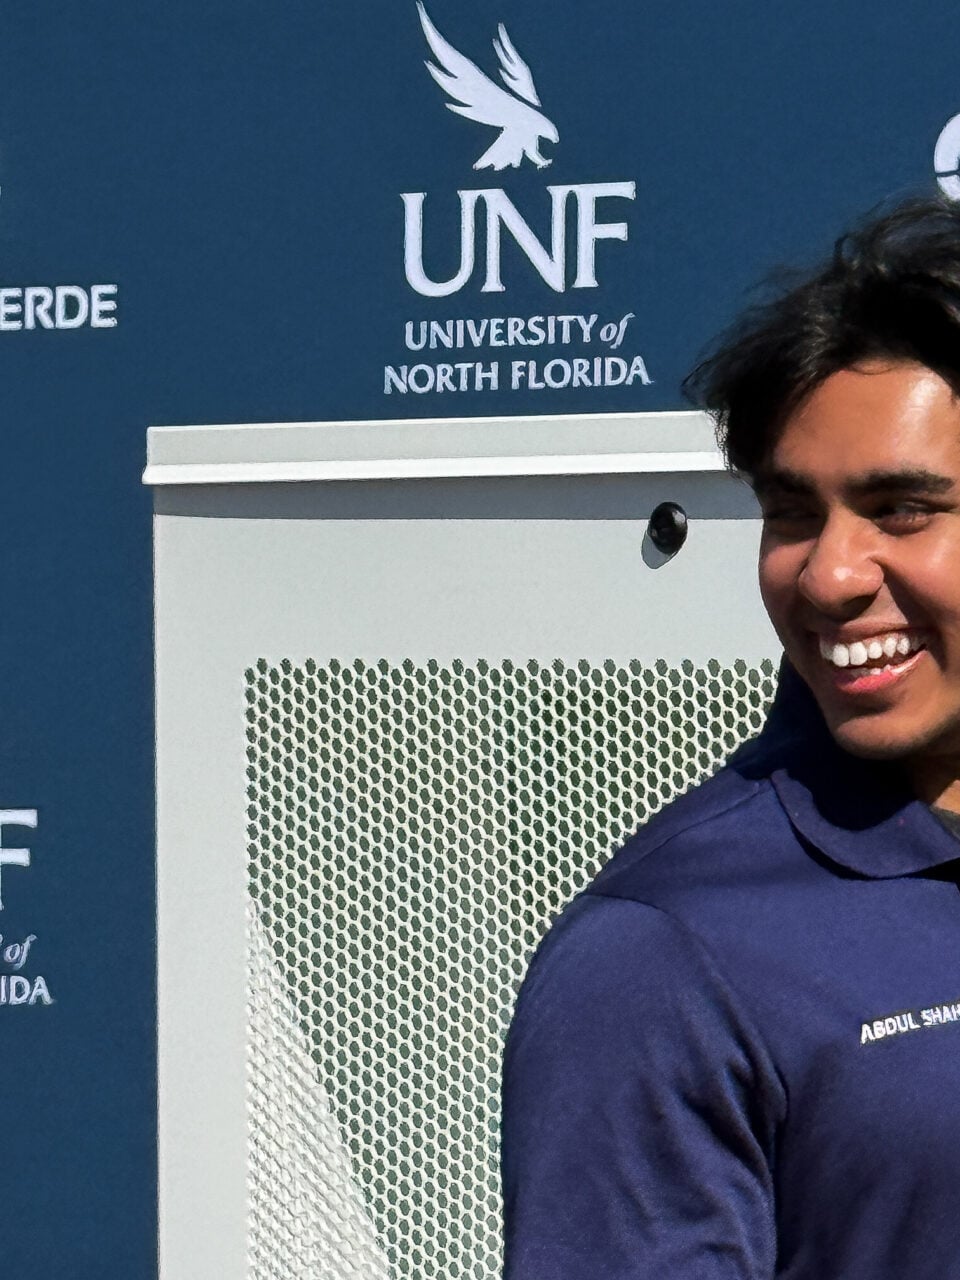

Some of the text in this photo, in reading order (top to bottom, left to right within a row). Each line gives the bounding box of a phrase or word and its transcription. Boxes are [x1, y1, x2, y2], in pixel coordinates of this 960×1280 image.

[400, 181, 637, 298] UNF
[405, 313, 636, 352] UNIVERSITY of
[384, 355, 653, 395] NORTH FLORIDA
[4, 934, 38, 969] of
[860, 1012, 921, 1045] ABDUL
